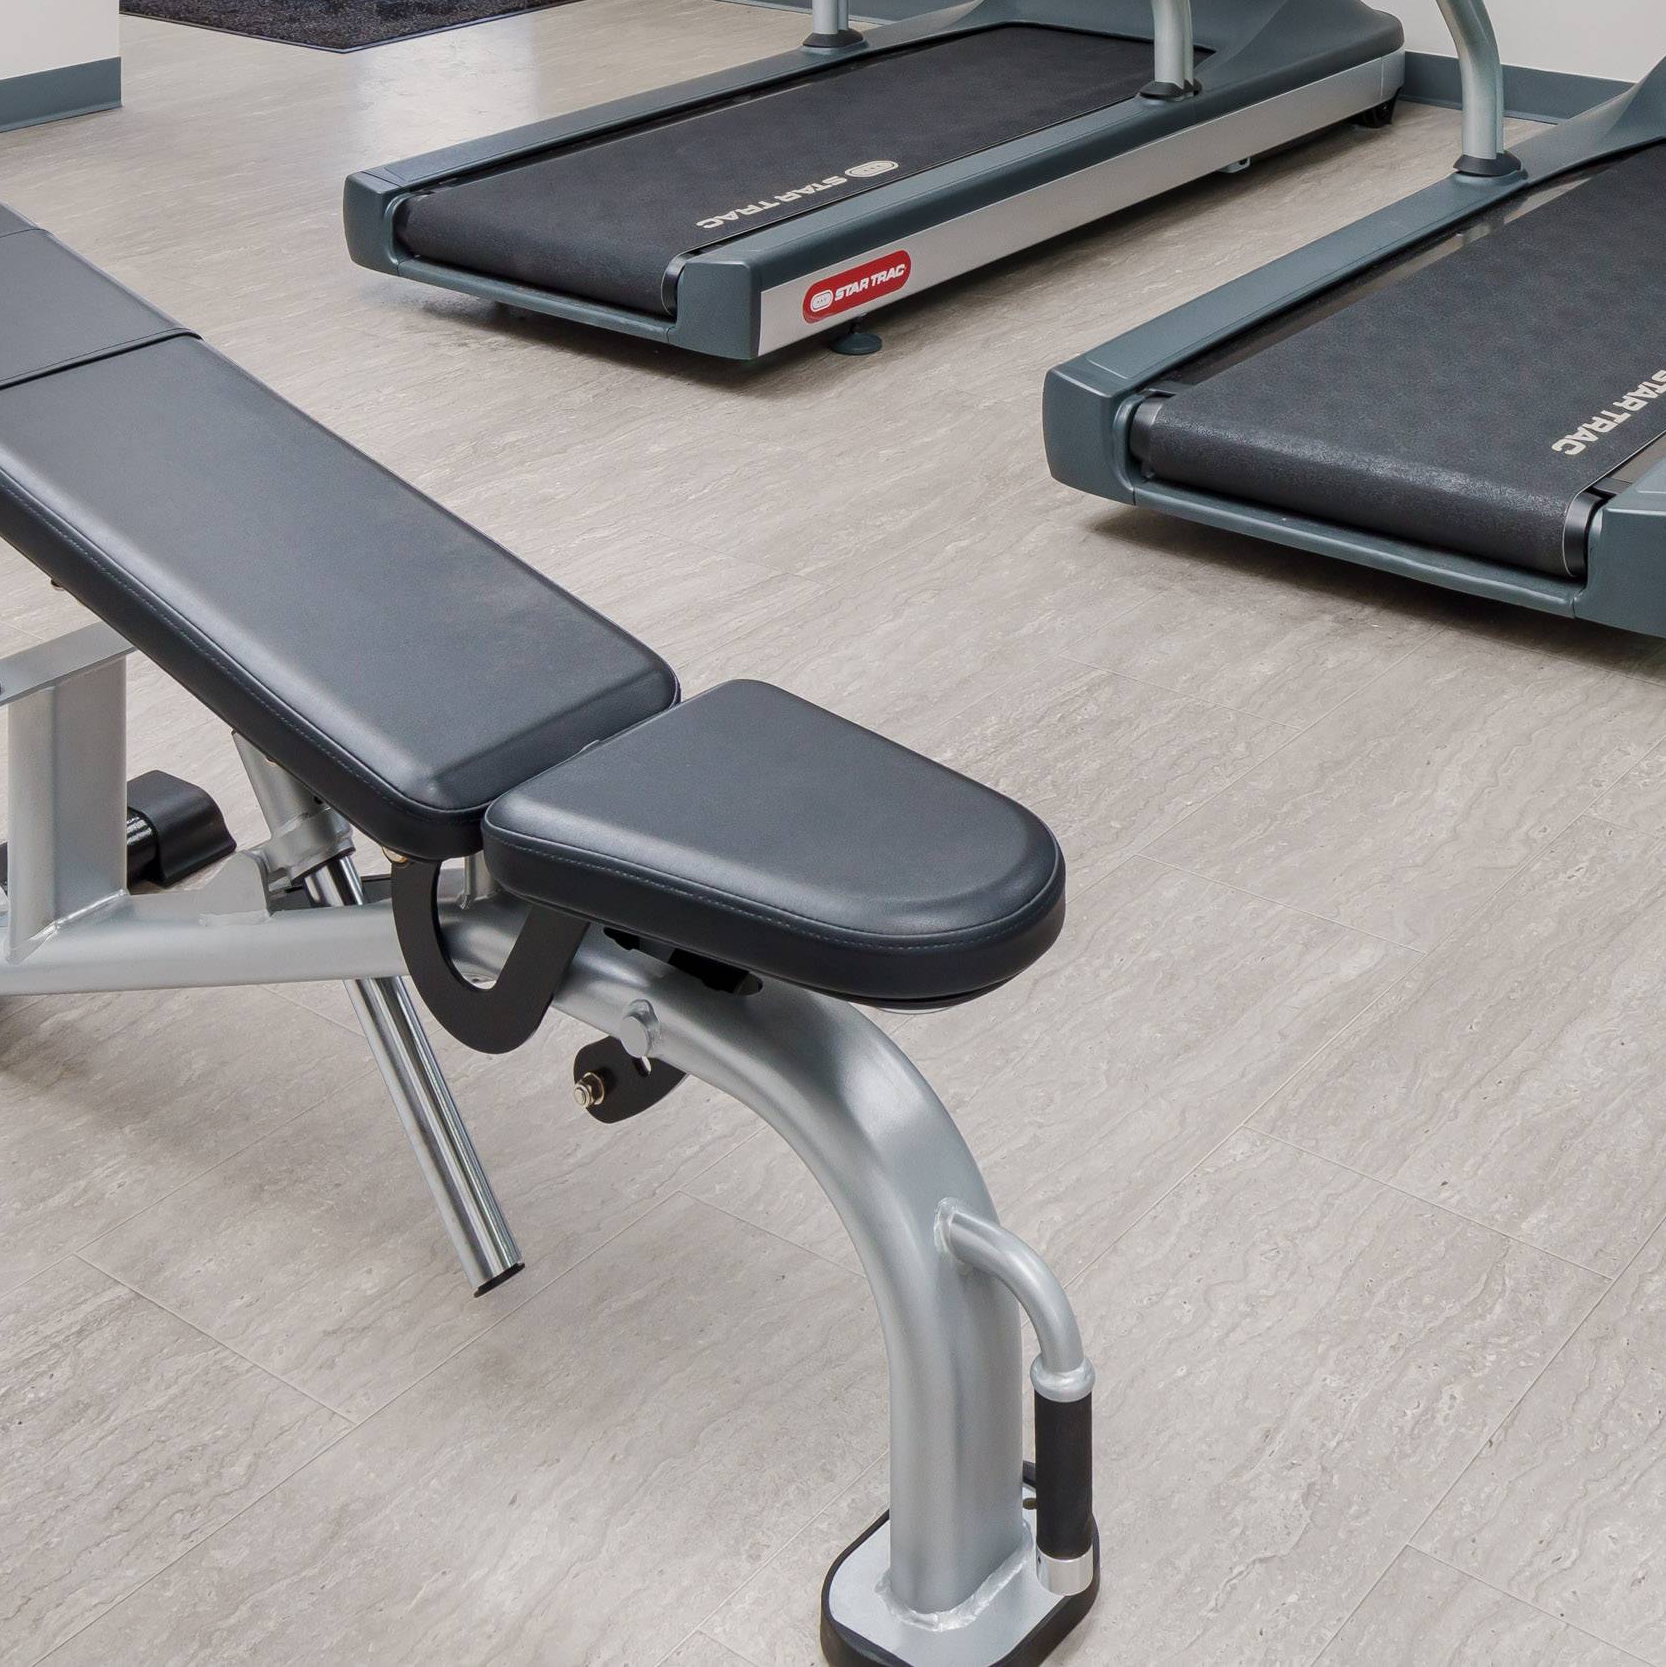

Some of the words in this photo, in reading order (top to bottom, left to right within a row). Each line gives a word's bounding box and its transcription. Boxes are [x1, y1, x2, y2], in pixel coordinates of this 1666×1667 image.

[774, 175, 847, 202] STAR
[696, 200, 780, 229] TRAC
[834, 278, 869, 301] STAR
[871, 264, 906, 287] TRAC
[1551, 410, 1631, 455] TRAC
